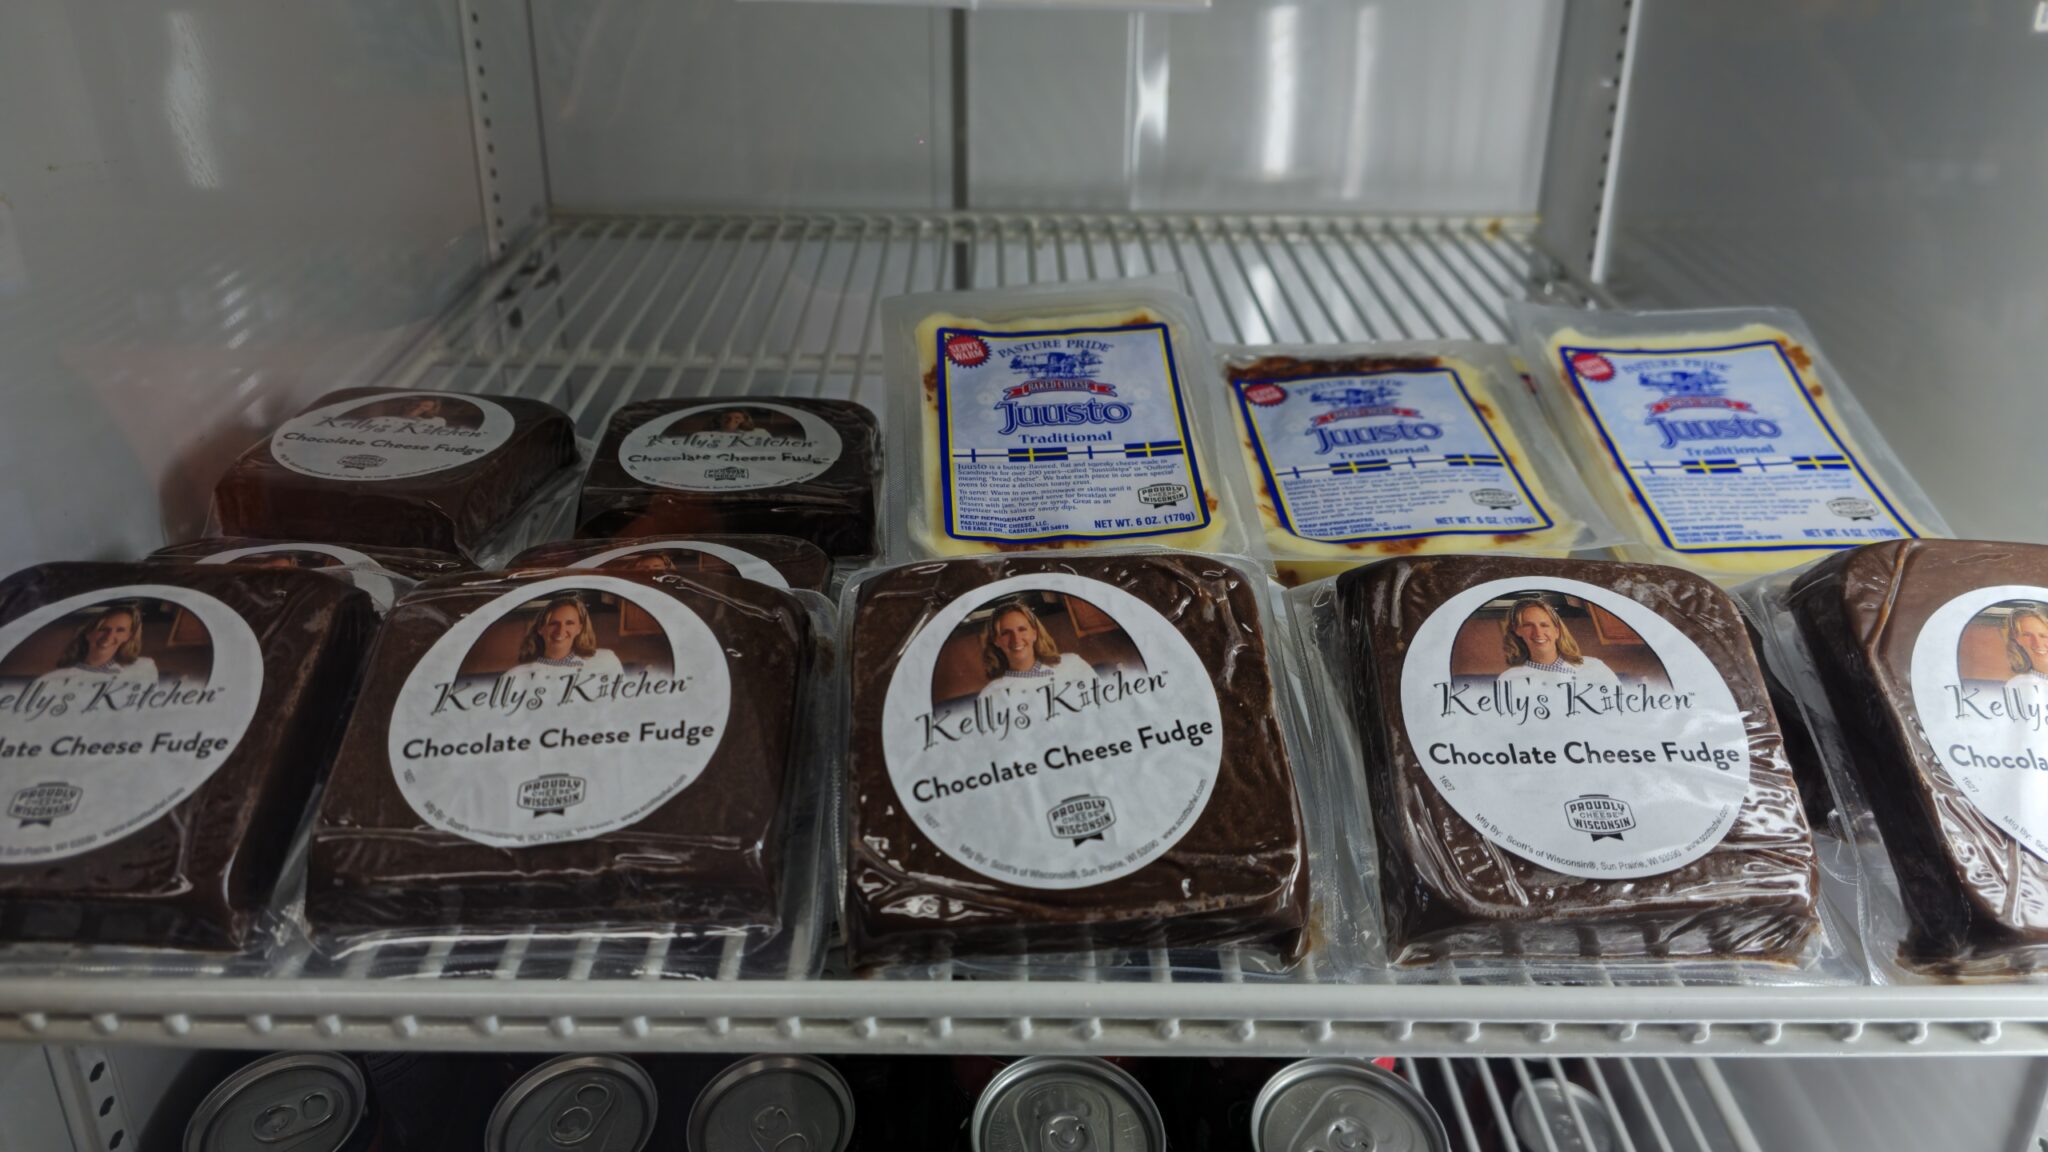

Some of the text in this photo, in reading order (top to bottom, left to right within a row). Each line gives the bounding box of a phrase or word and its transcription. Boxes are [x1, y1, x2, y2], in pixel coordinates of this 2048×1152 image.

[952, 349, 985, 361] WARM
[997, 339, 1062, 359] PASTURE
[993, 397, 1132, 436] Juusto
[1018, 430, 1113, 444] Traditional
[1304, 420, 1444, 455] Juusto
[1644, 413, 1783, 450] Juusto
[283, 431, 365, 446] Chocolate
[370, 439, 430, 451] Cheese
[433, 443, 485, 456] Fudge
[1337, 444, 1431, 460] Traditional
[1684, 444, 1776, 456] Traditional
[628, 452, 711, 463] Chocolate
[1142, 486, 1183, 496] PROUDLY
[1142, 493, 1185, 503] WISCONSIN
[1094, 511, 1196, 529] NET WT. 6 OZ. (170g)
[0, 679, 77, 722] elly's
[430, 672, 547, 716] Kelly's
[1432, 676, 1551, 726] Kelly's
[915, 686, 1031, 751] Kelly's
[50, 736, 143, 758] Cheese
[151, 730, 229, 759] Fudge
[402, 720, 715, 760] Chocolate Cheese Fudge
[912, 719, 1214, 803] Chocolate Cheese Fudge
[1428, 740, 1741, 771] Chocolate Cheese Fudge
[1948, 743, 2048, 772] Chocola
[19, 787, 77, 801] PROUDLY
[524, 778, 581, 793] PROUDLY
[1438, 774, 1456, 793] 1627
[1961, 776, 1980, 794] 1627
[14, 803, 73, 817] WISCONSIN
[522, 792, 580, 807] WISCONSIN
[1051, 799, 1106, 822] PROUDLY
[1569, 799, 1625, 814] PROUDLY
[1055, 813, 1111, 836] WISCONSIN
[1573, 816, 1631, 831] WISCONSIN
[2002, 815, 2033, 842] Mfg By:
[1474, 812, 1490, 829] Mfg
[1490, 824, 1503, 839] By:
[1505, 834, 1535, 855] Scott's
[1535, 849, 1545, 858] of
[1600, 861, 1617, 872] Sun
[1618, 860, 1648, 872] Prairie,
[1649, 857, 1658, 867] WI
[959, 843, 973, 860] Mfg
[990, 858, 1018, 875] Scott's
[1019, 869, 1029, 877] of
[1081, 866, 1098, 878] Sun
[1126, 852, 1138, 864] WI
